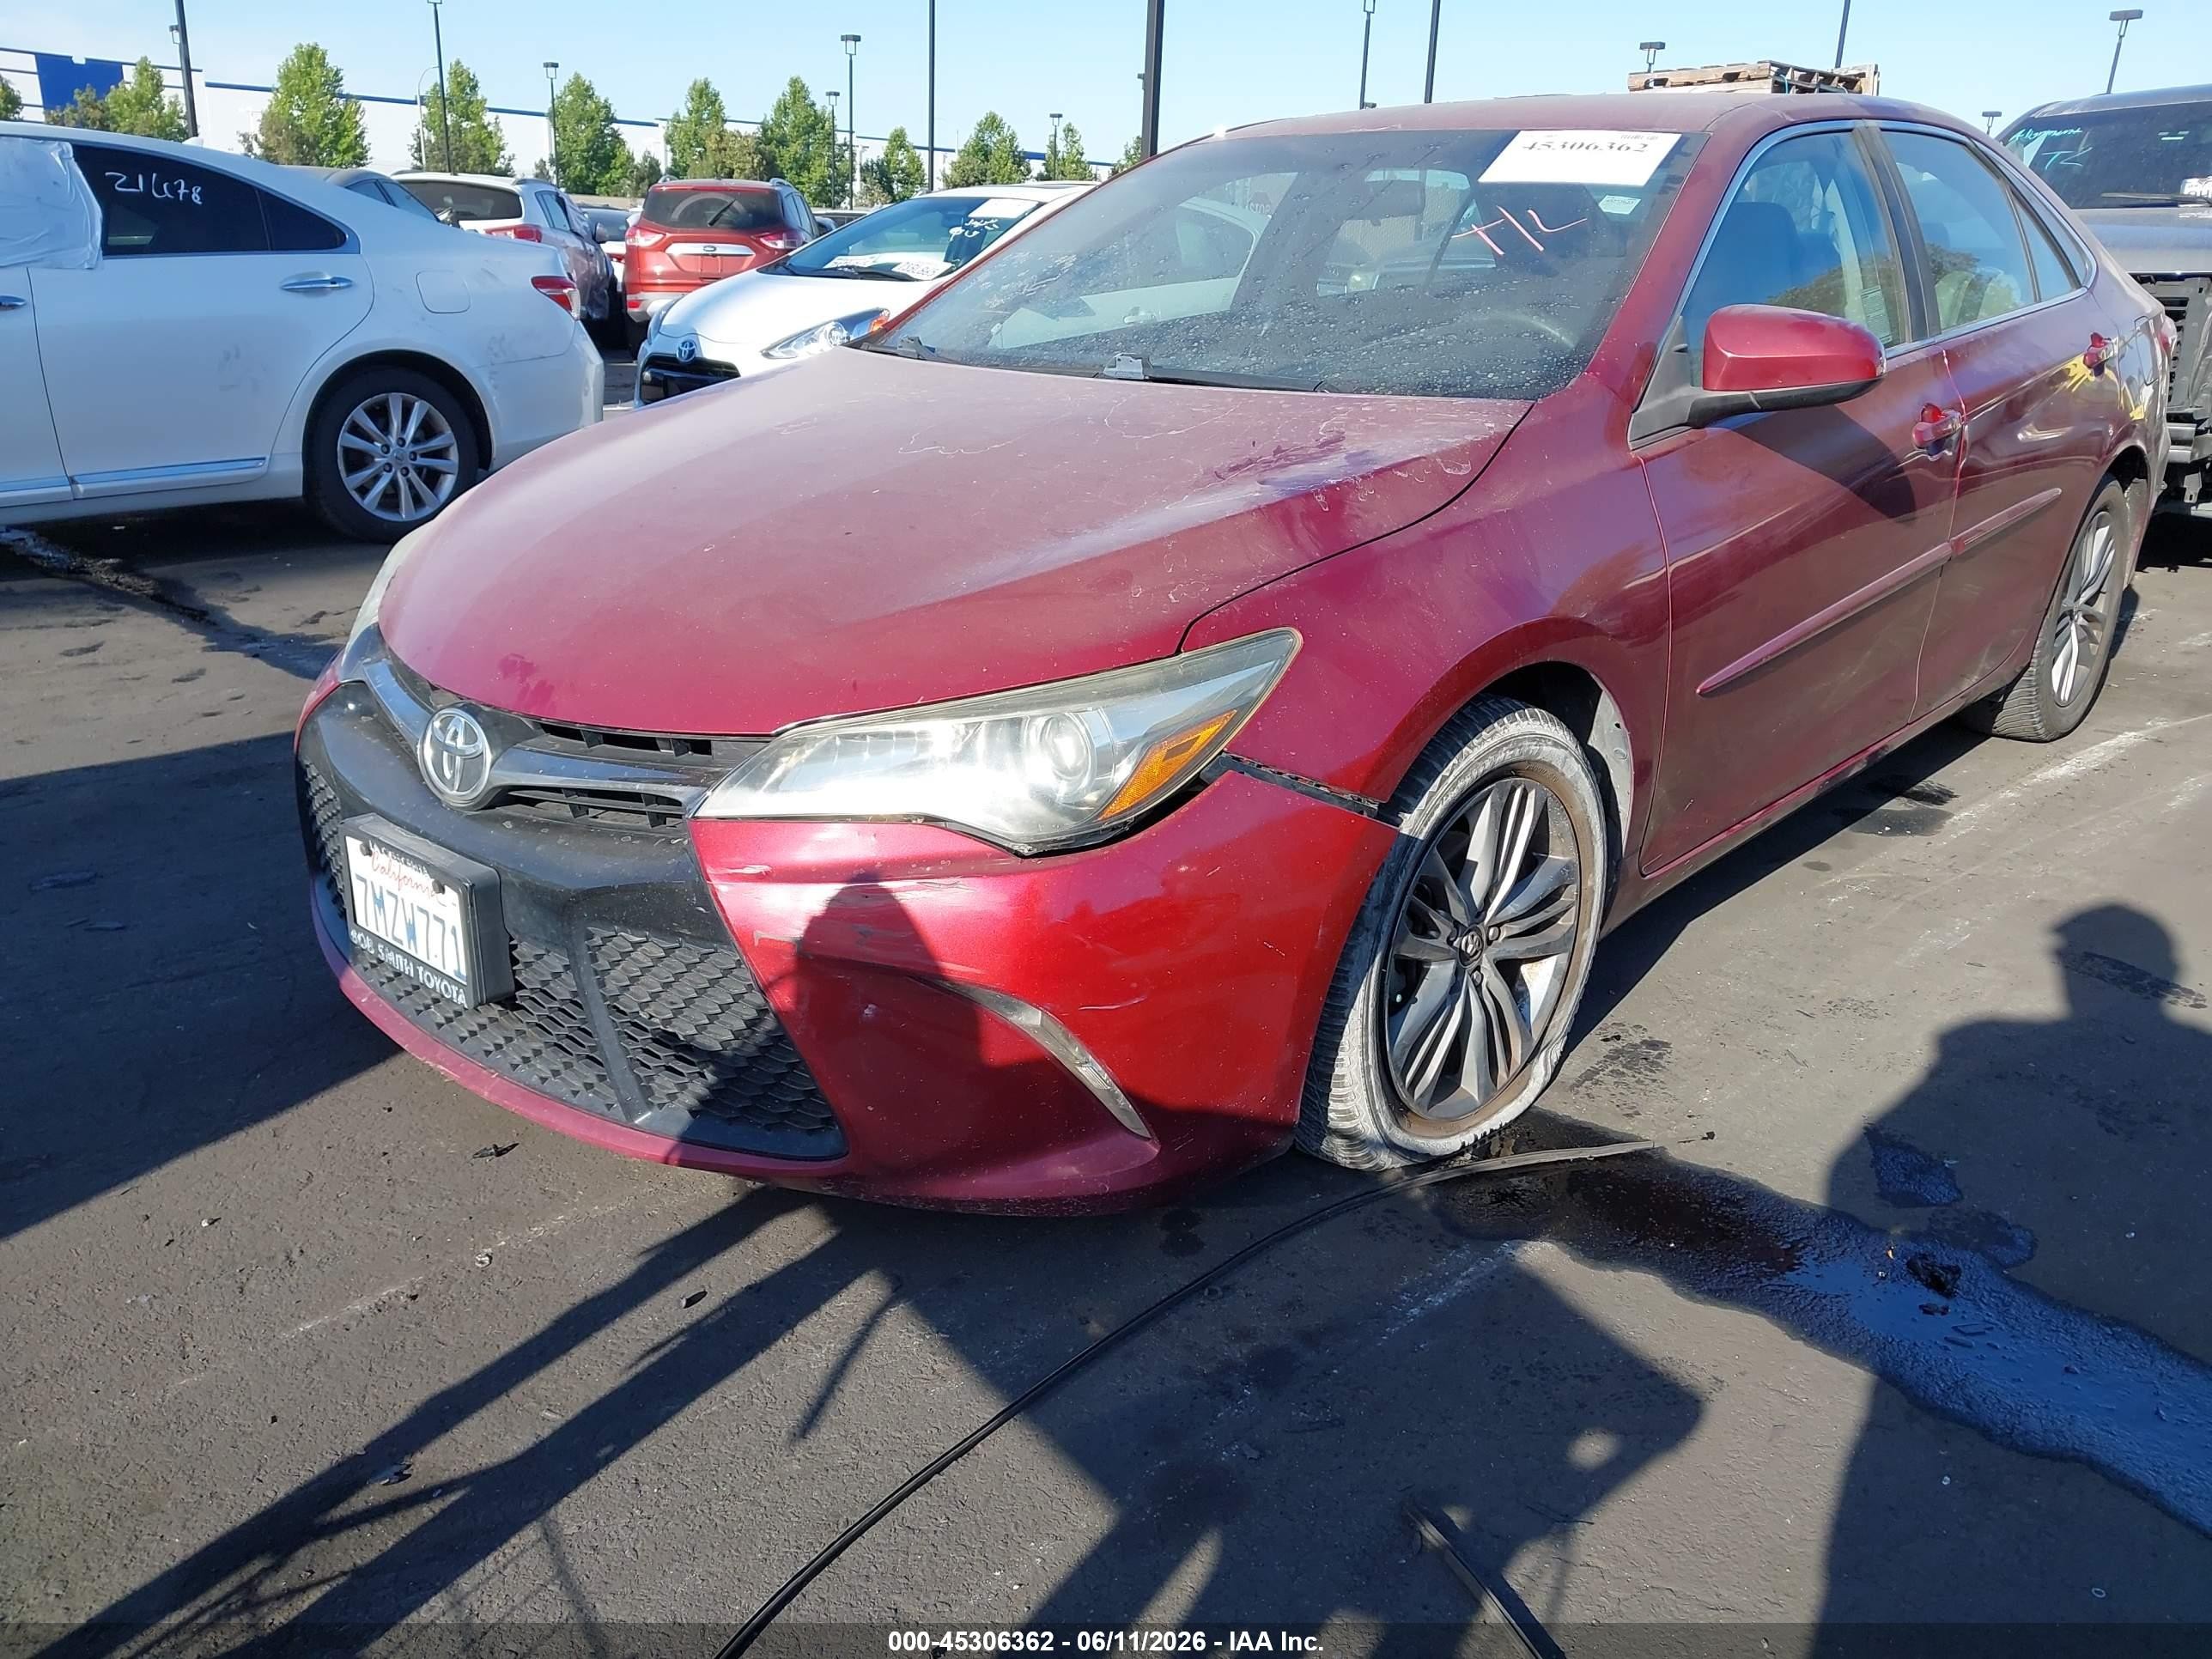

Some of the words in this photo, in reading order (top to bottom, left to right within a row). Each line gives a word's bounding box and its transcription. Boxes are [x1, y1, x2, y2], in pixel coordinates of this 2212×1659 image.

[1522, 140, 1649, 152] 45306362
[350, 928, 375, 955] BOB
[377, 944, 414, 978] SMITH
[416, 965, 469, 1010] TOYOTA
